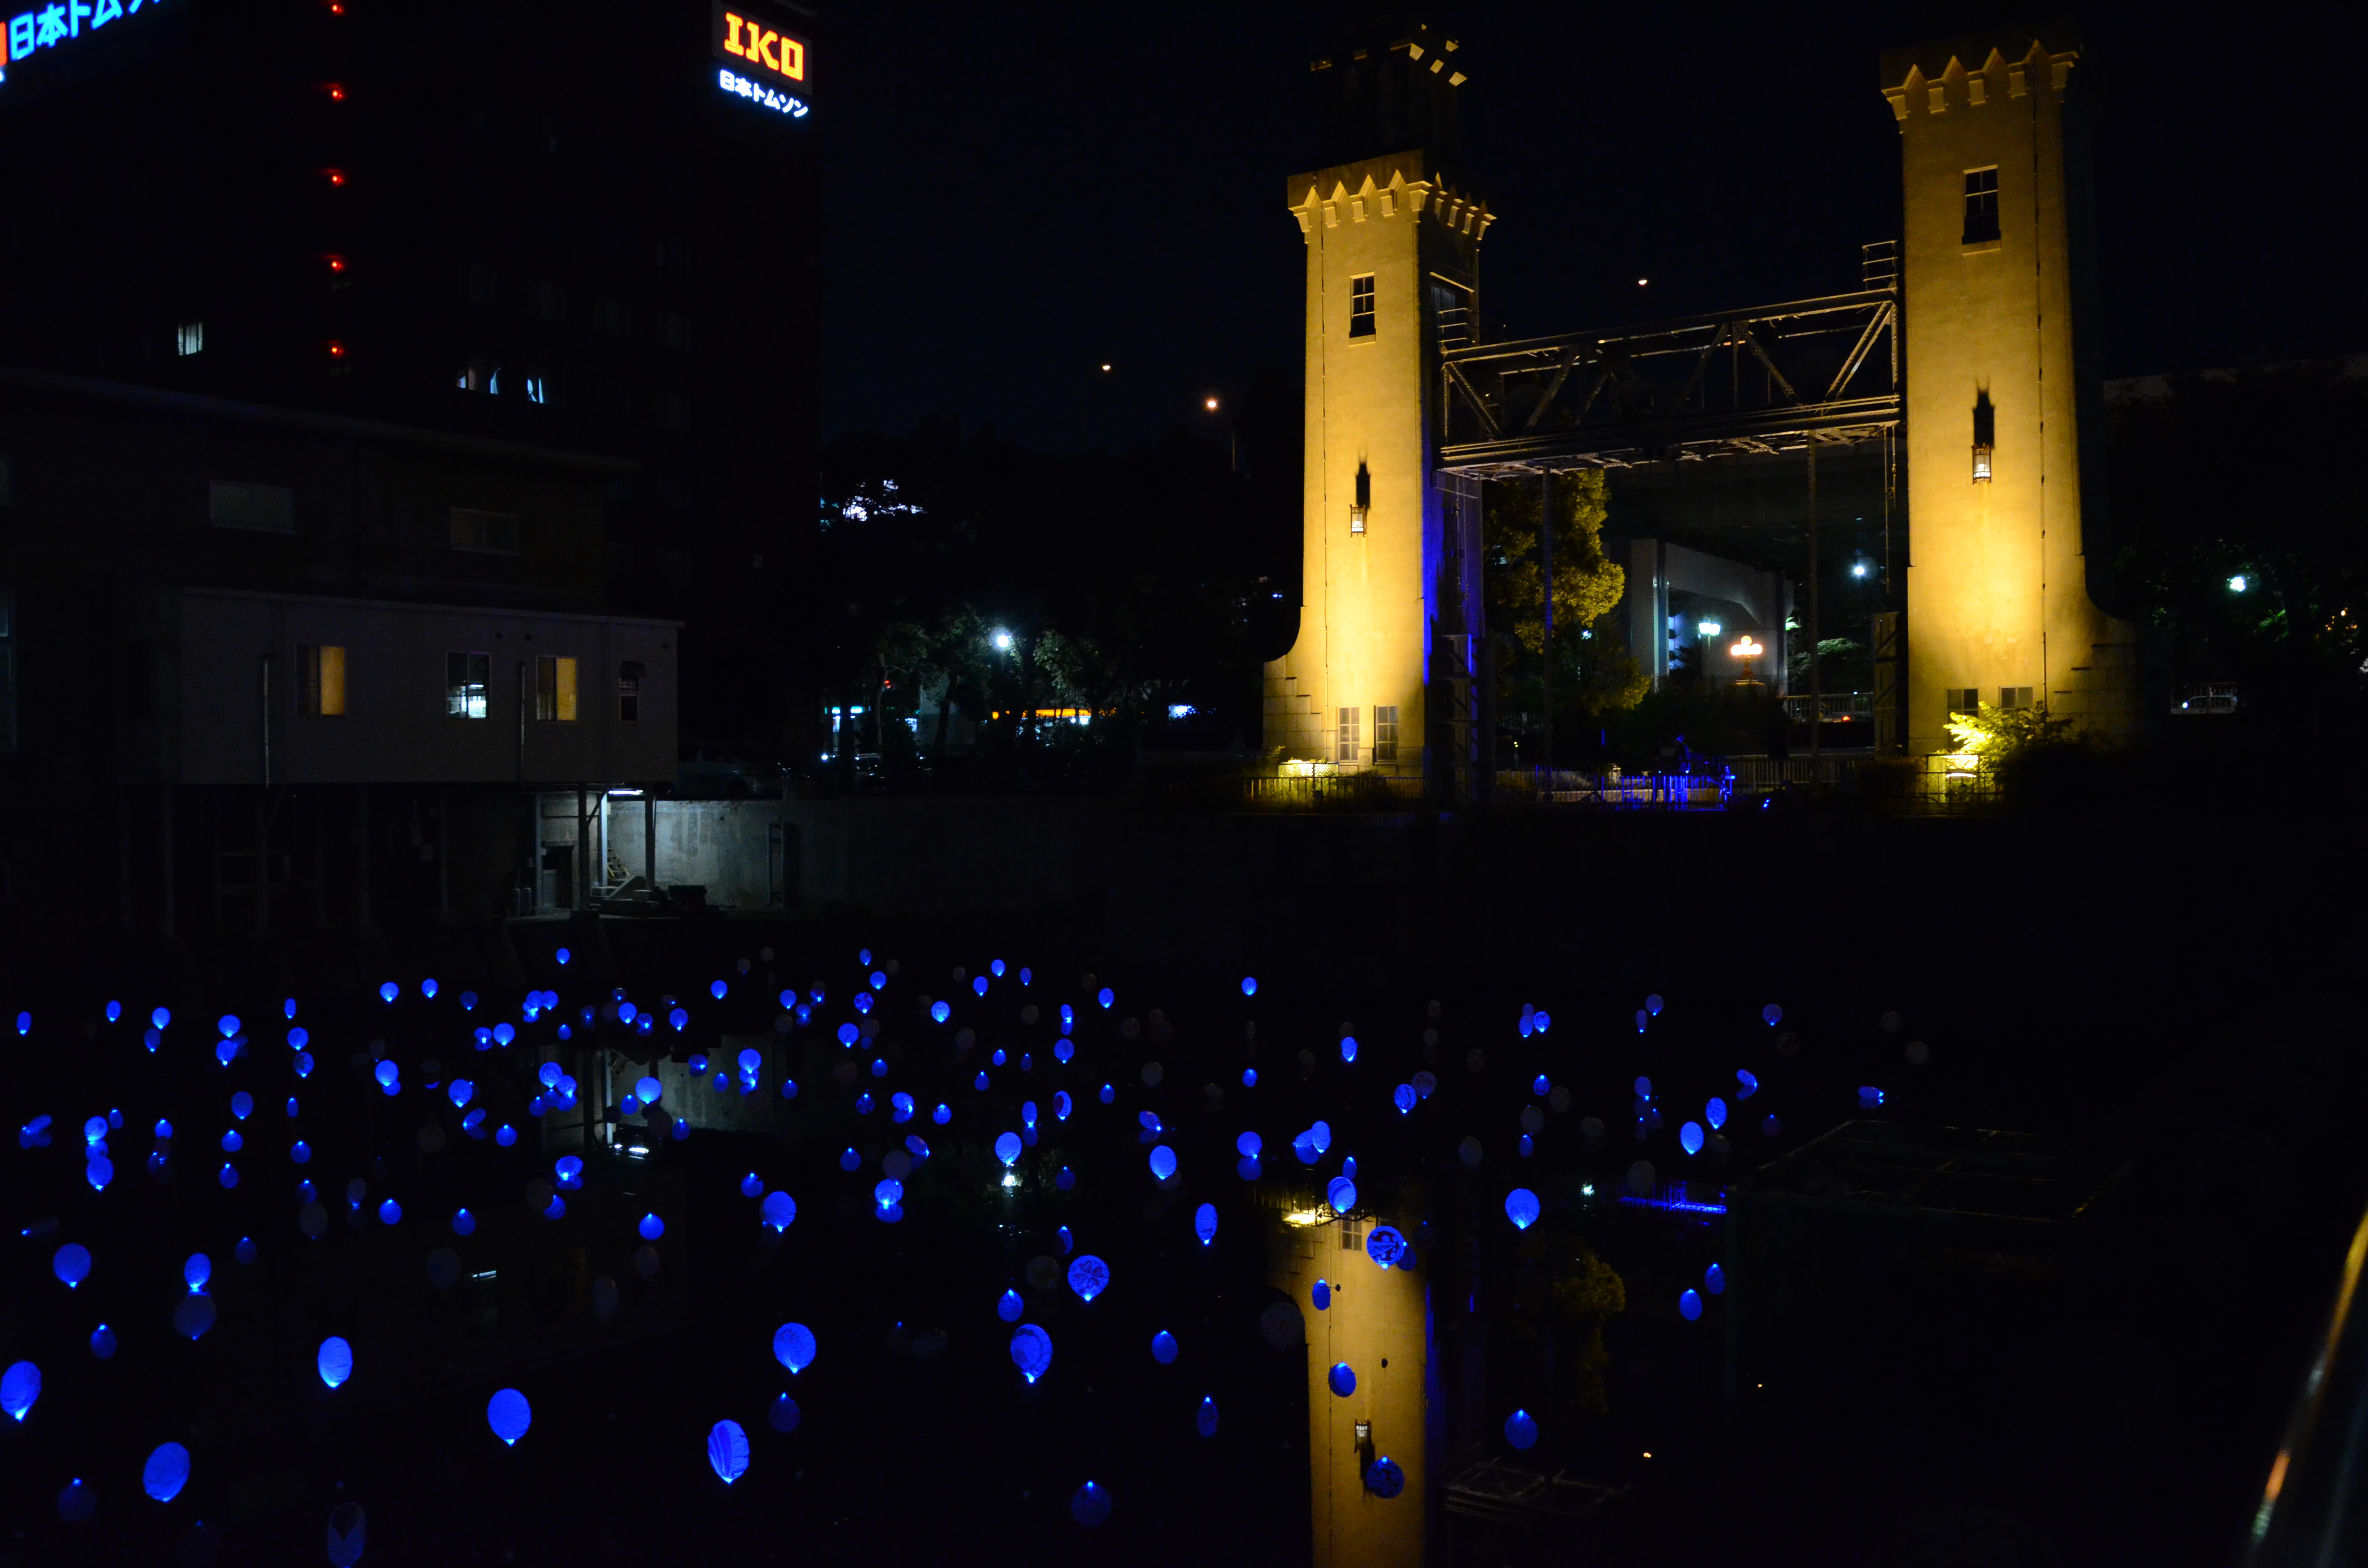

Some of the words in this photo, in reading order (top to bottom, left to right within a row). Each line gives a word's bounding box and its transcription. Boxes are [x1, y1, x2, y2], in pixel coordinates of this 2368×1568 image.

[9, 0, 161, 61] 日本トム
[724, 12, 803, 81] IKO
[720, 69, 808, 117] 日本トムソン
